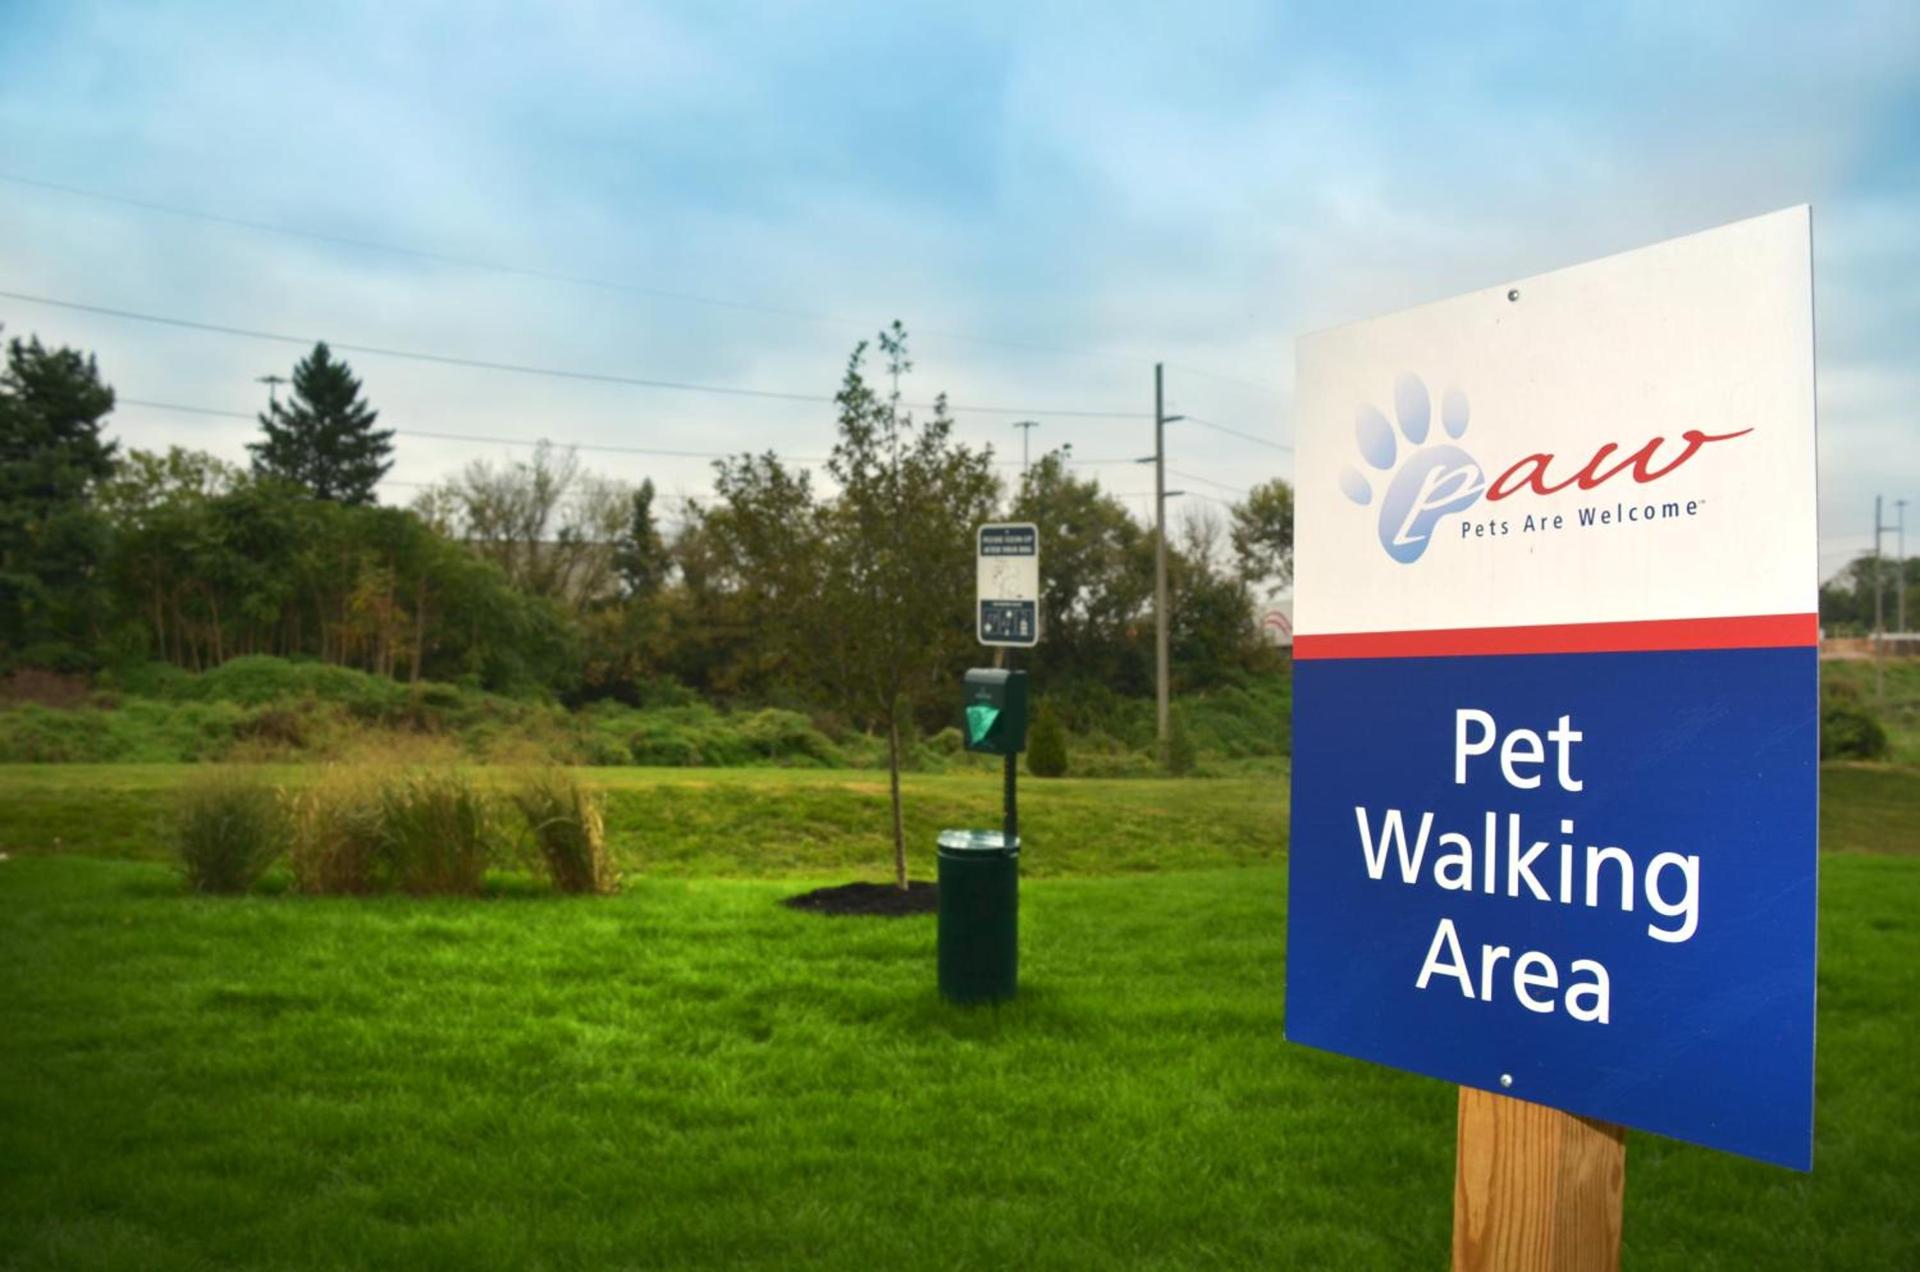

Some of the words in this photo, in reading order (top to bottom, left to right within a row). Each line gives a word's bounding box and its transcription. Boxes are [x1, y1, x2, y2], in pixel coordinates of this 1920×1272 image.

[1461, 518, 1509, 538] Pets
[1523, 514, 1563, 533] Are
[1455, 708, 1583, 792] Pet
[1355, 806, 1700, 943] Walking
[1415, 918, 1610, 1024] Area
